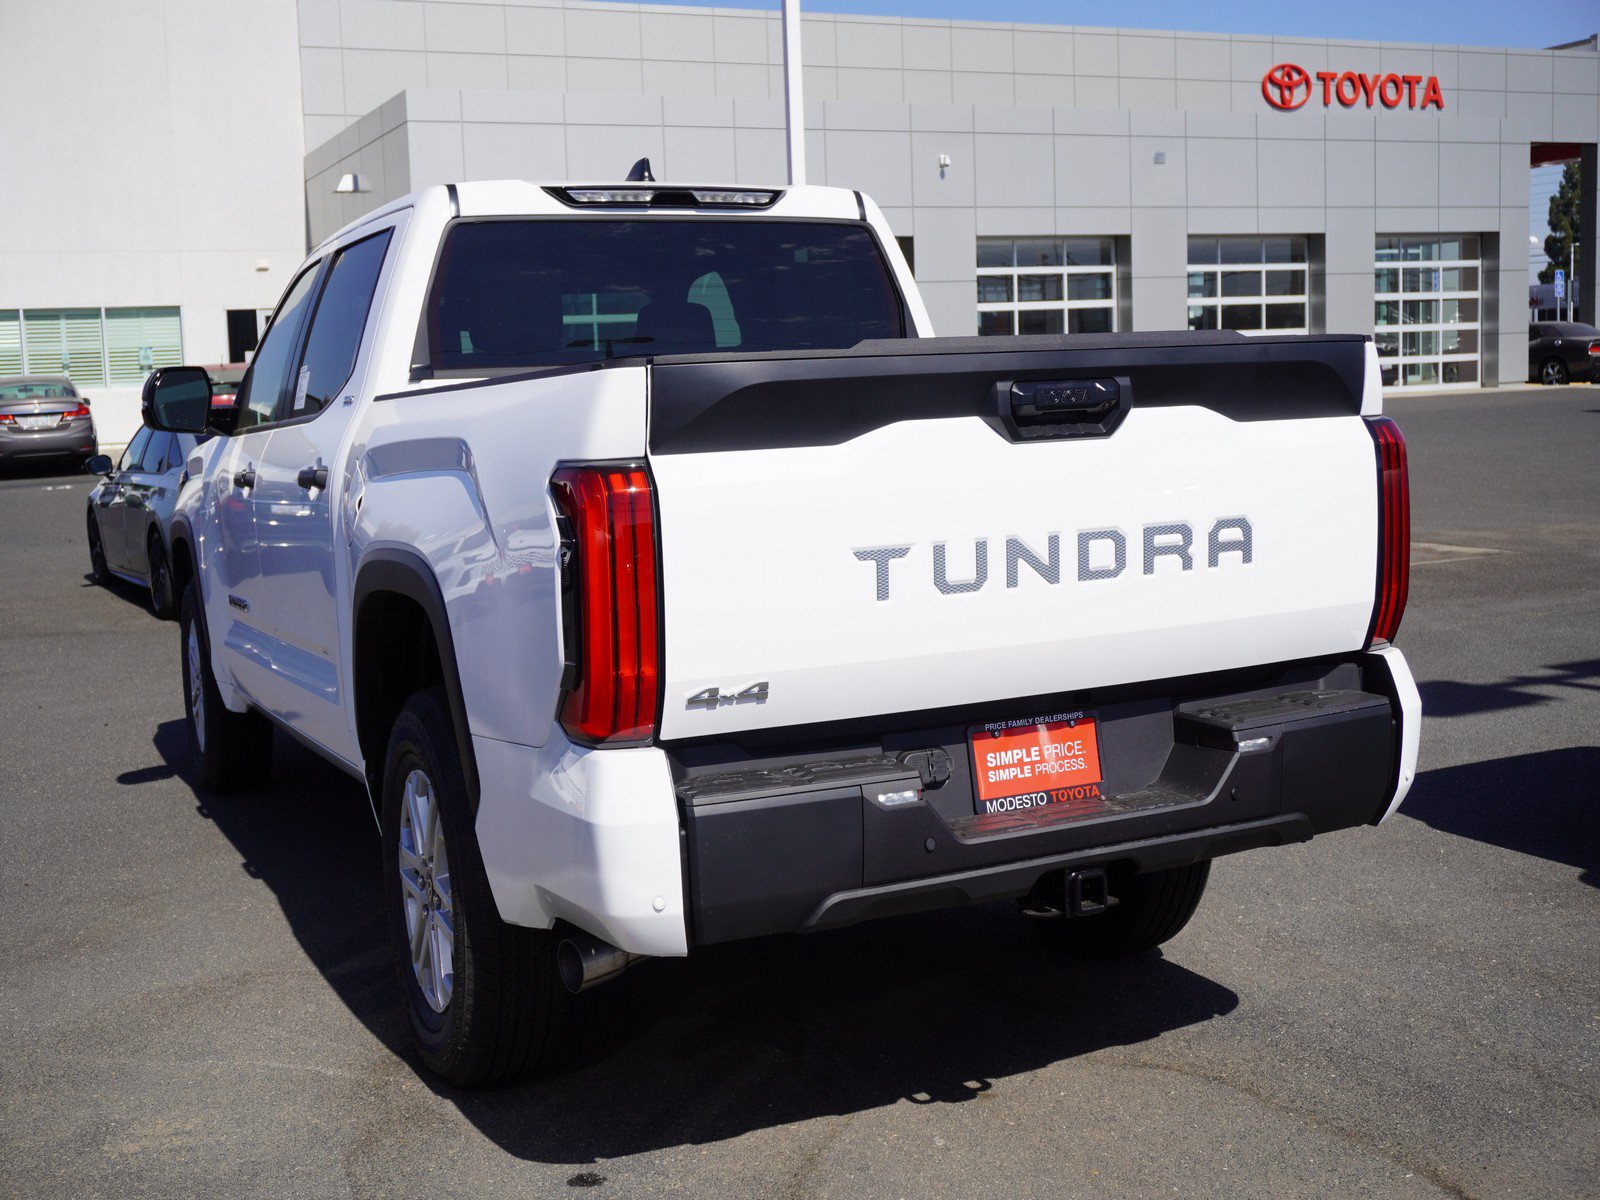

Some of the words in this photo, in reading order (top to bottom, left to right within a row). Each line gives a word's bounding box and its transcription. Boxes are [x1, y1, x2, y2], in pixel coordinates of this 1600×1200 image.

[1316, 71, 1445, 109] TOYOTA
[851, 514, 1254, 602] TUNDRA
[984, 720, 1007, 732] PRICE
[1008, 717, 1034, 729] FAMILY
[1034, 711, 1084, 725] DEALERSHIPS
[986, 746, 1041, 768] SIMPLE
[1043, 740, 1087, 760] PRICE.
[988, 765, 1033, 783] SIMPLE
[1035, 757, 1088, 776] PROCESS.
[986, 792, 1048, 814] MODESTO
[1050, 784, 1101, 803] TOYOTA
